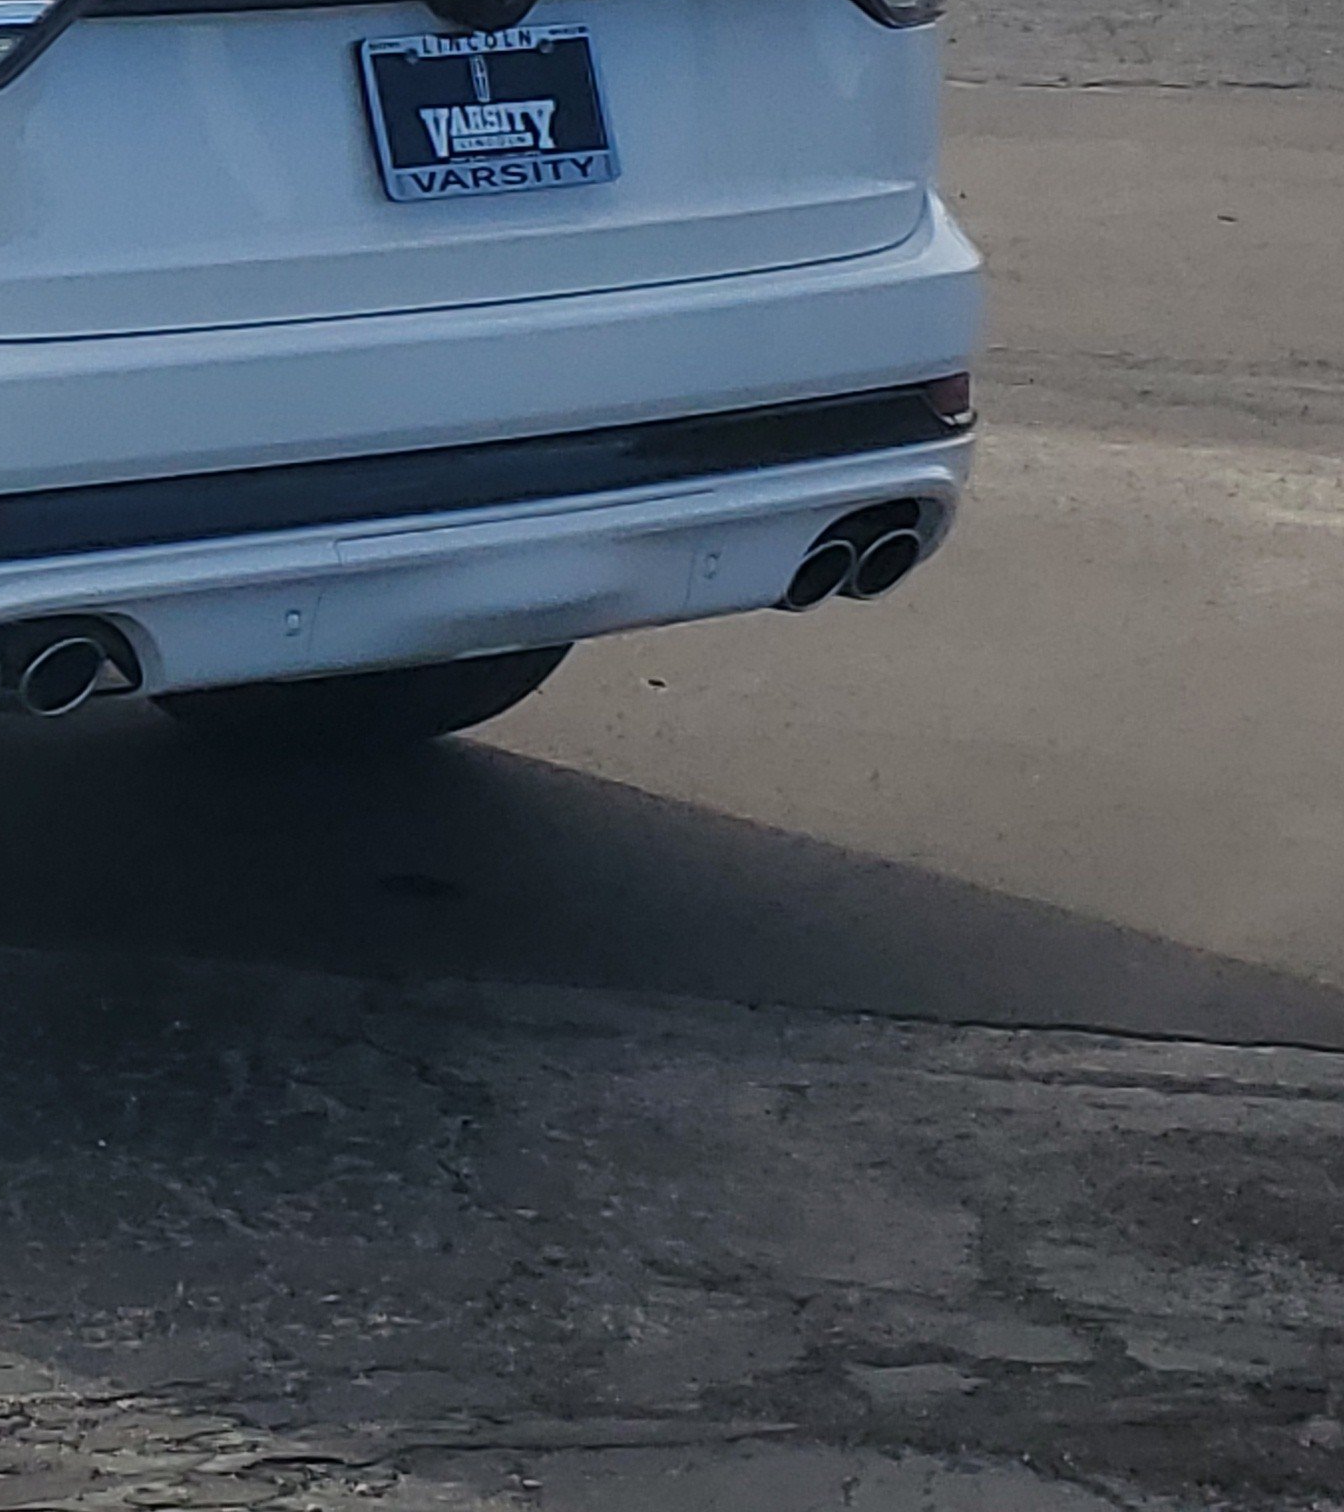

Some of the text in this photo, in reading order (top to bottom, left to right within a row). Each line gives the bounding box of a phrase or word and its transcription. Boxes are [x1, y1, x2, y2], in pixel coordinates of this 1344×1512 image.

[421, 29, 532, 55] LINCOLN
[419, 99, 555, 157] VARSITY
[411, 156, 594, 193] VARSITY
